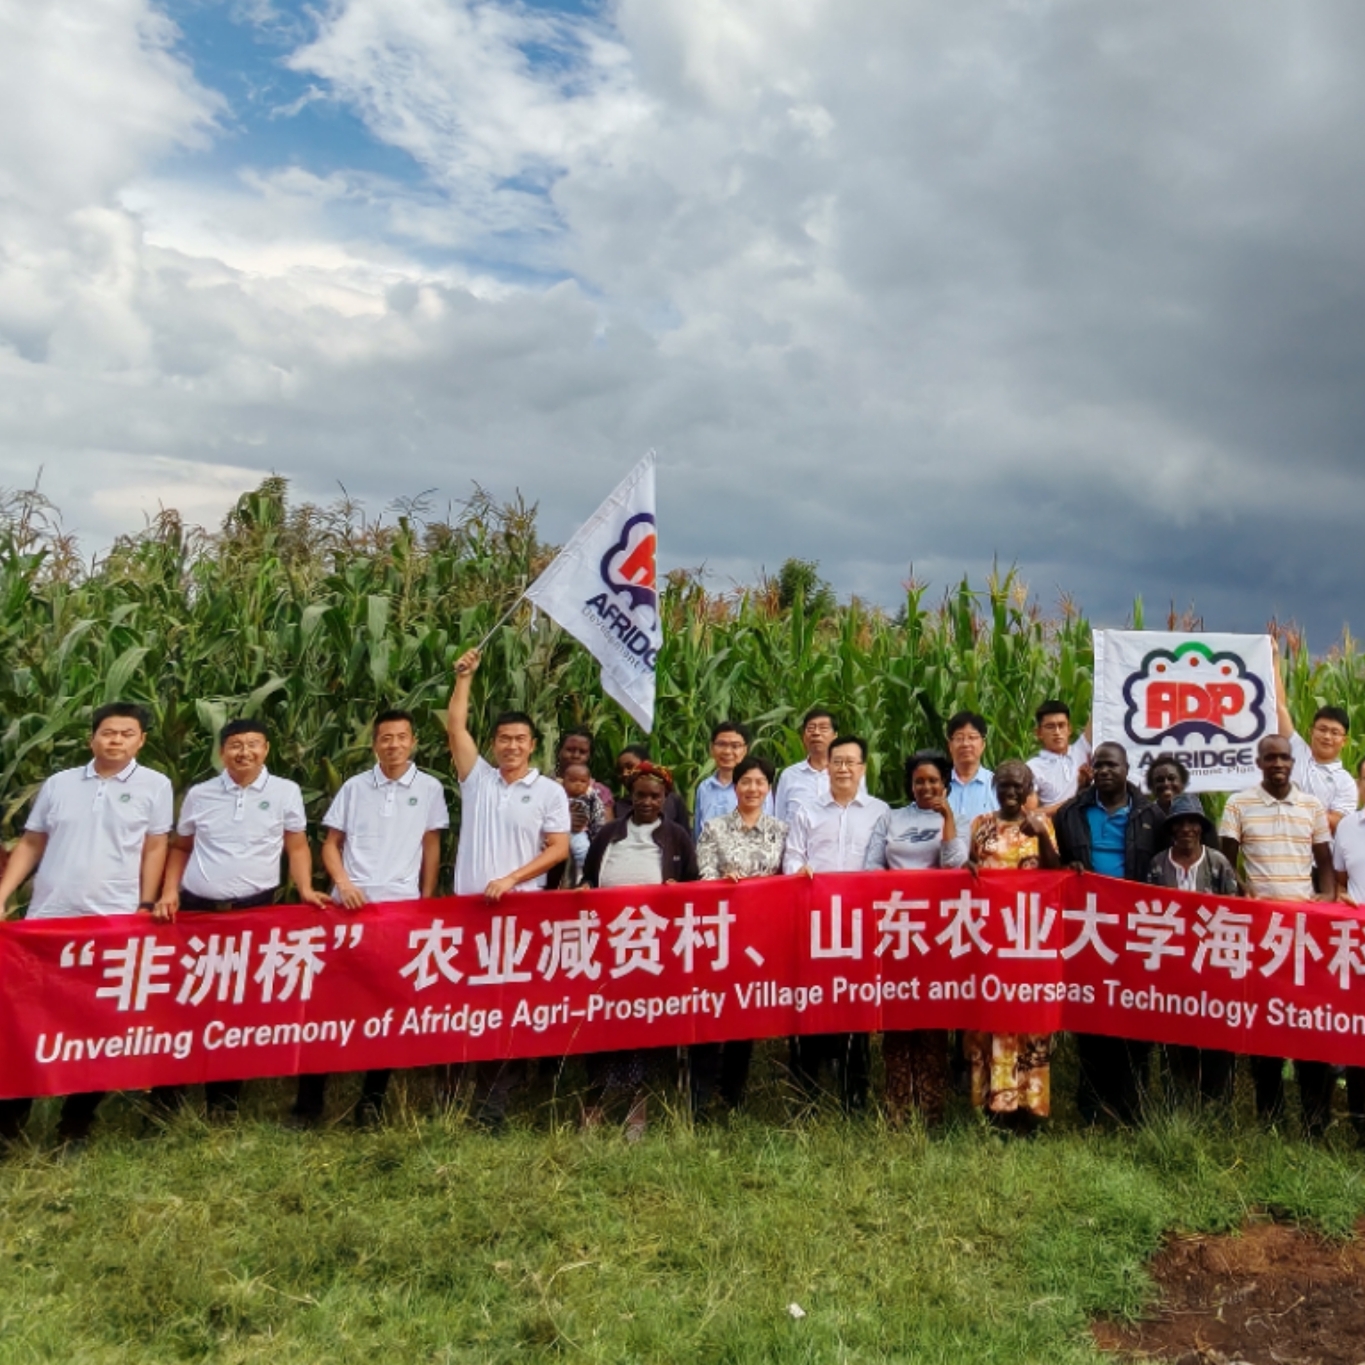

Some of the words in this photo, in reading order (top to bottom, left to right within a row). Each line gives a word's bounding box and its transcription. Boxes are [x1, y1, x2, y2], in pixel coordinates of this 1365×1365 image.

[1145, 681, 1245, 729] ADP
[1138, 748, 1253, 768] ARIDGE
[35, 1026, 193, 1064] Unveiling
[203, 1018, 355, 1050] Ceremony
[364, 1008, 394, 1038] of
[399, 1003, 503, 1038] Afridge
[735, 980, 824, 1012] Village
[832, 975, 920, 1006] Project
[929, 974, 976, 1000] and
[981, 974, 1095, 1003] Overseas
[1103, 979, 1258, 1028] Technology
